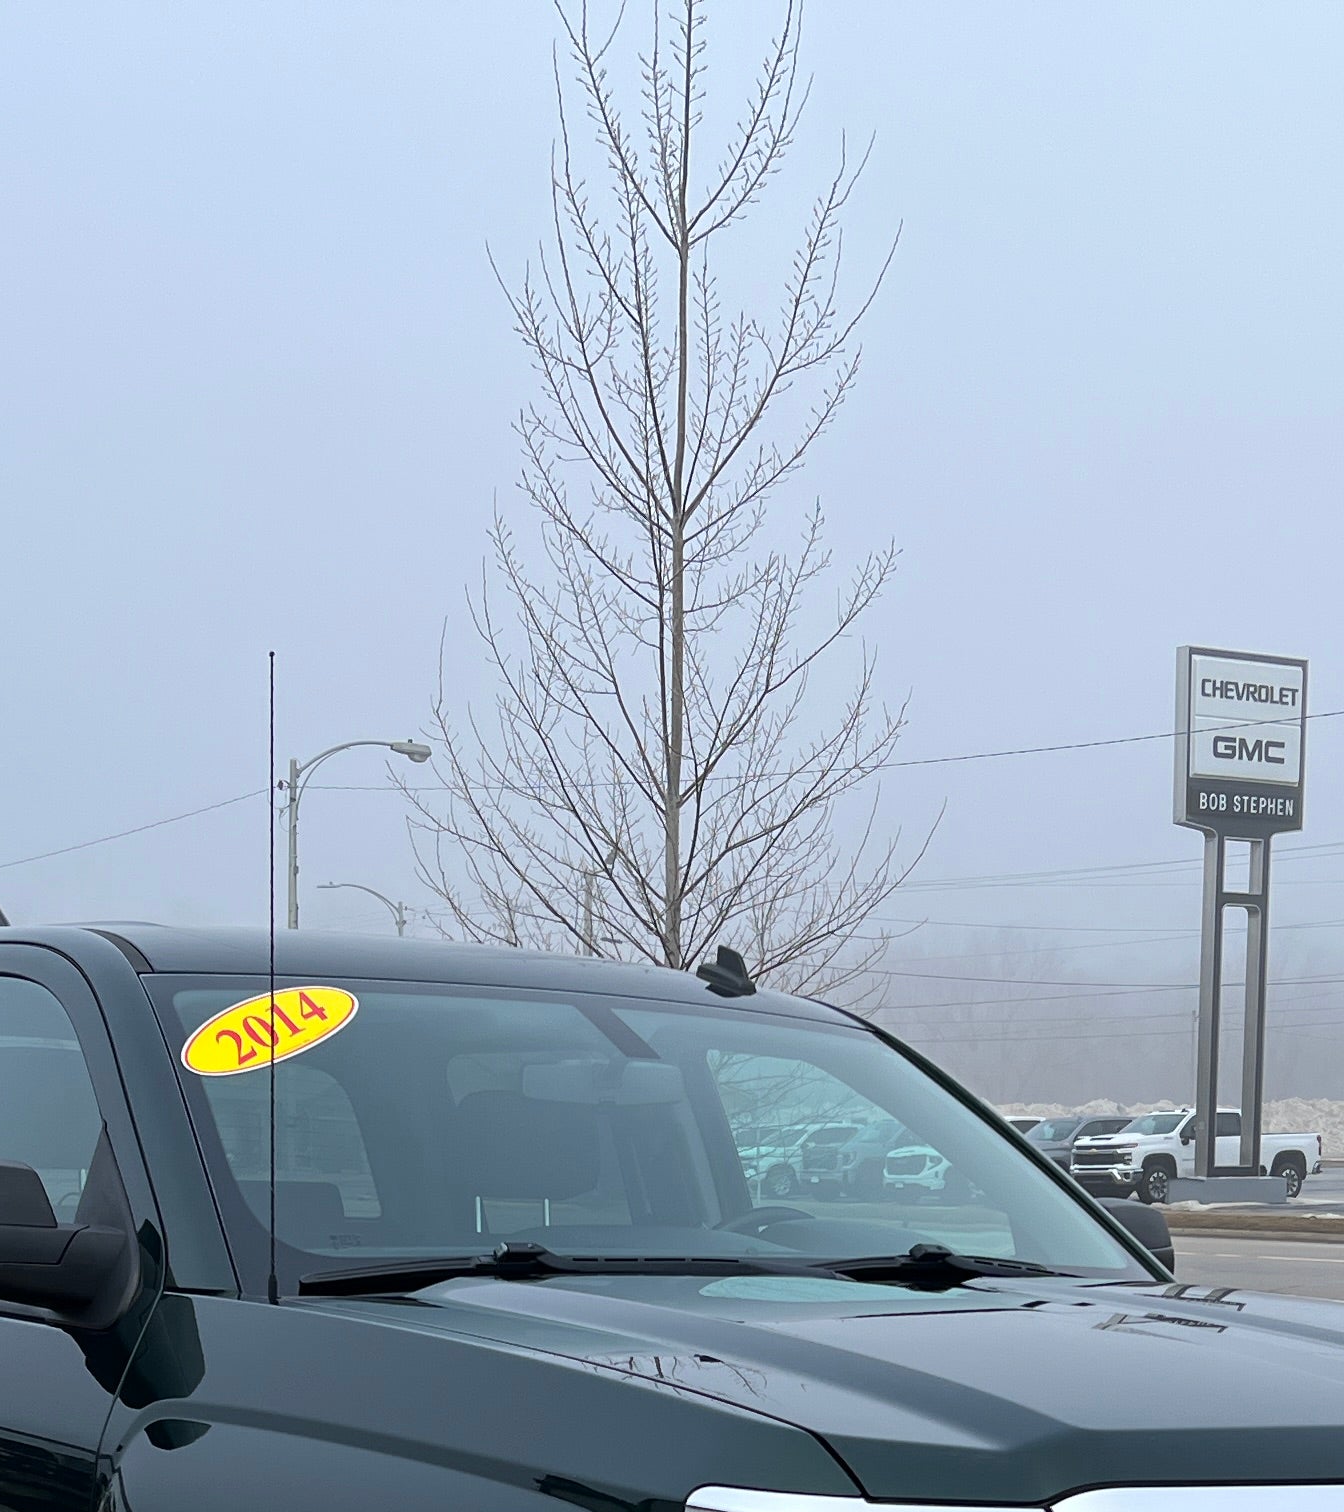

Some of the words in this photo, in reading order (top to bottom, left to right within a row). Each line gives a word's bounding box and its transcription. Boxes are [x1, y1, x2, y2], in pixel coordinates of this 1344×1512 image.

[1201, 678, 1299, 706] CHEVROLET
[1212, 735, 1285, 764] GMC
[1199, 792, 1227, 811] BOB
[1233, 796, 1293, 816] STEPHEN
[215, 991, 328, 1065] 2014
